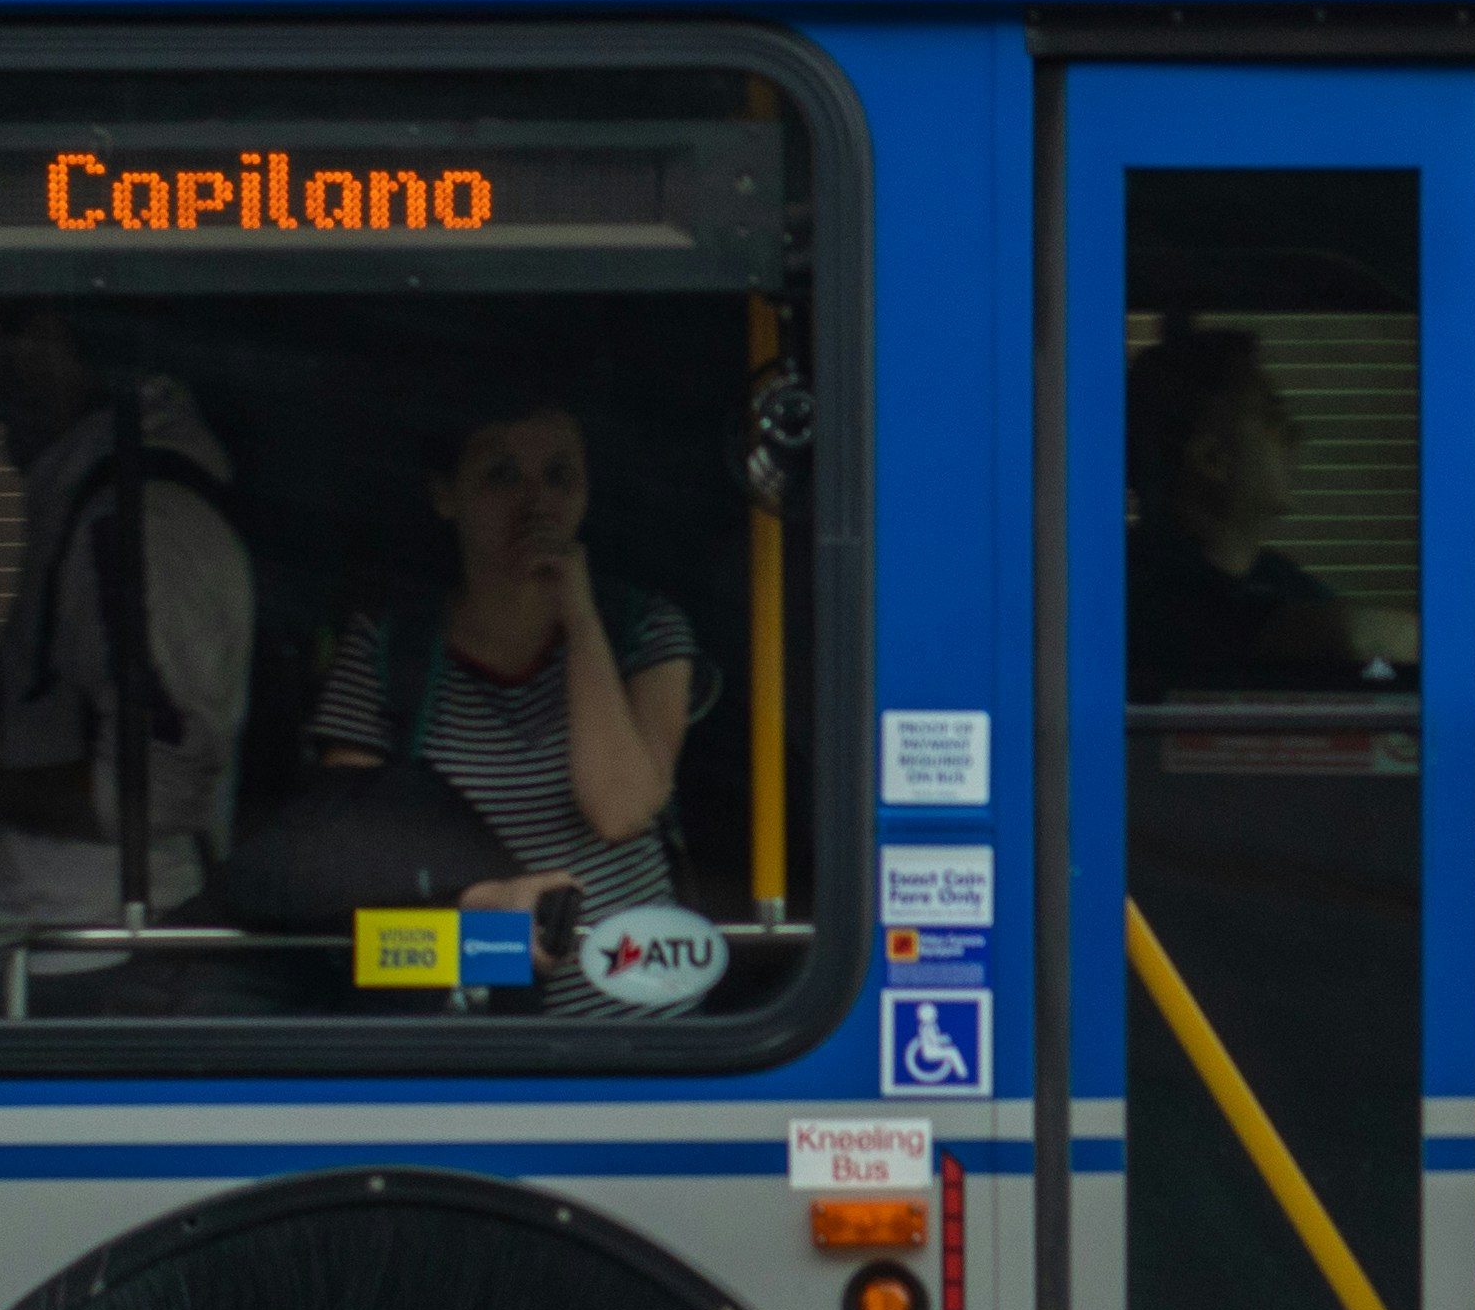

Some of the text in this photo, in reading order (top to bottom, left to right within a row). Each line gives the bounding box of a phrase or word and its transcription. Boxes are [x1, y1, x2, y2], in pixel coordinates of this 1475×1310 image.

[47, 152, 492, 231] Capilano
[379, 947, 438, 969] ZERO
[640, 937, 713, 970] ATU
[794, 1124, 926, 1158] Kneeling
[831, 1155, 890, 1182] Bus
